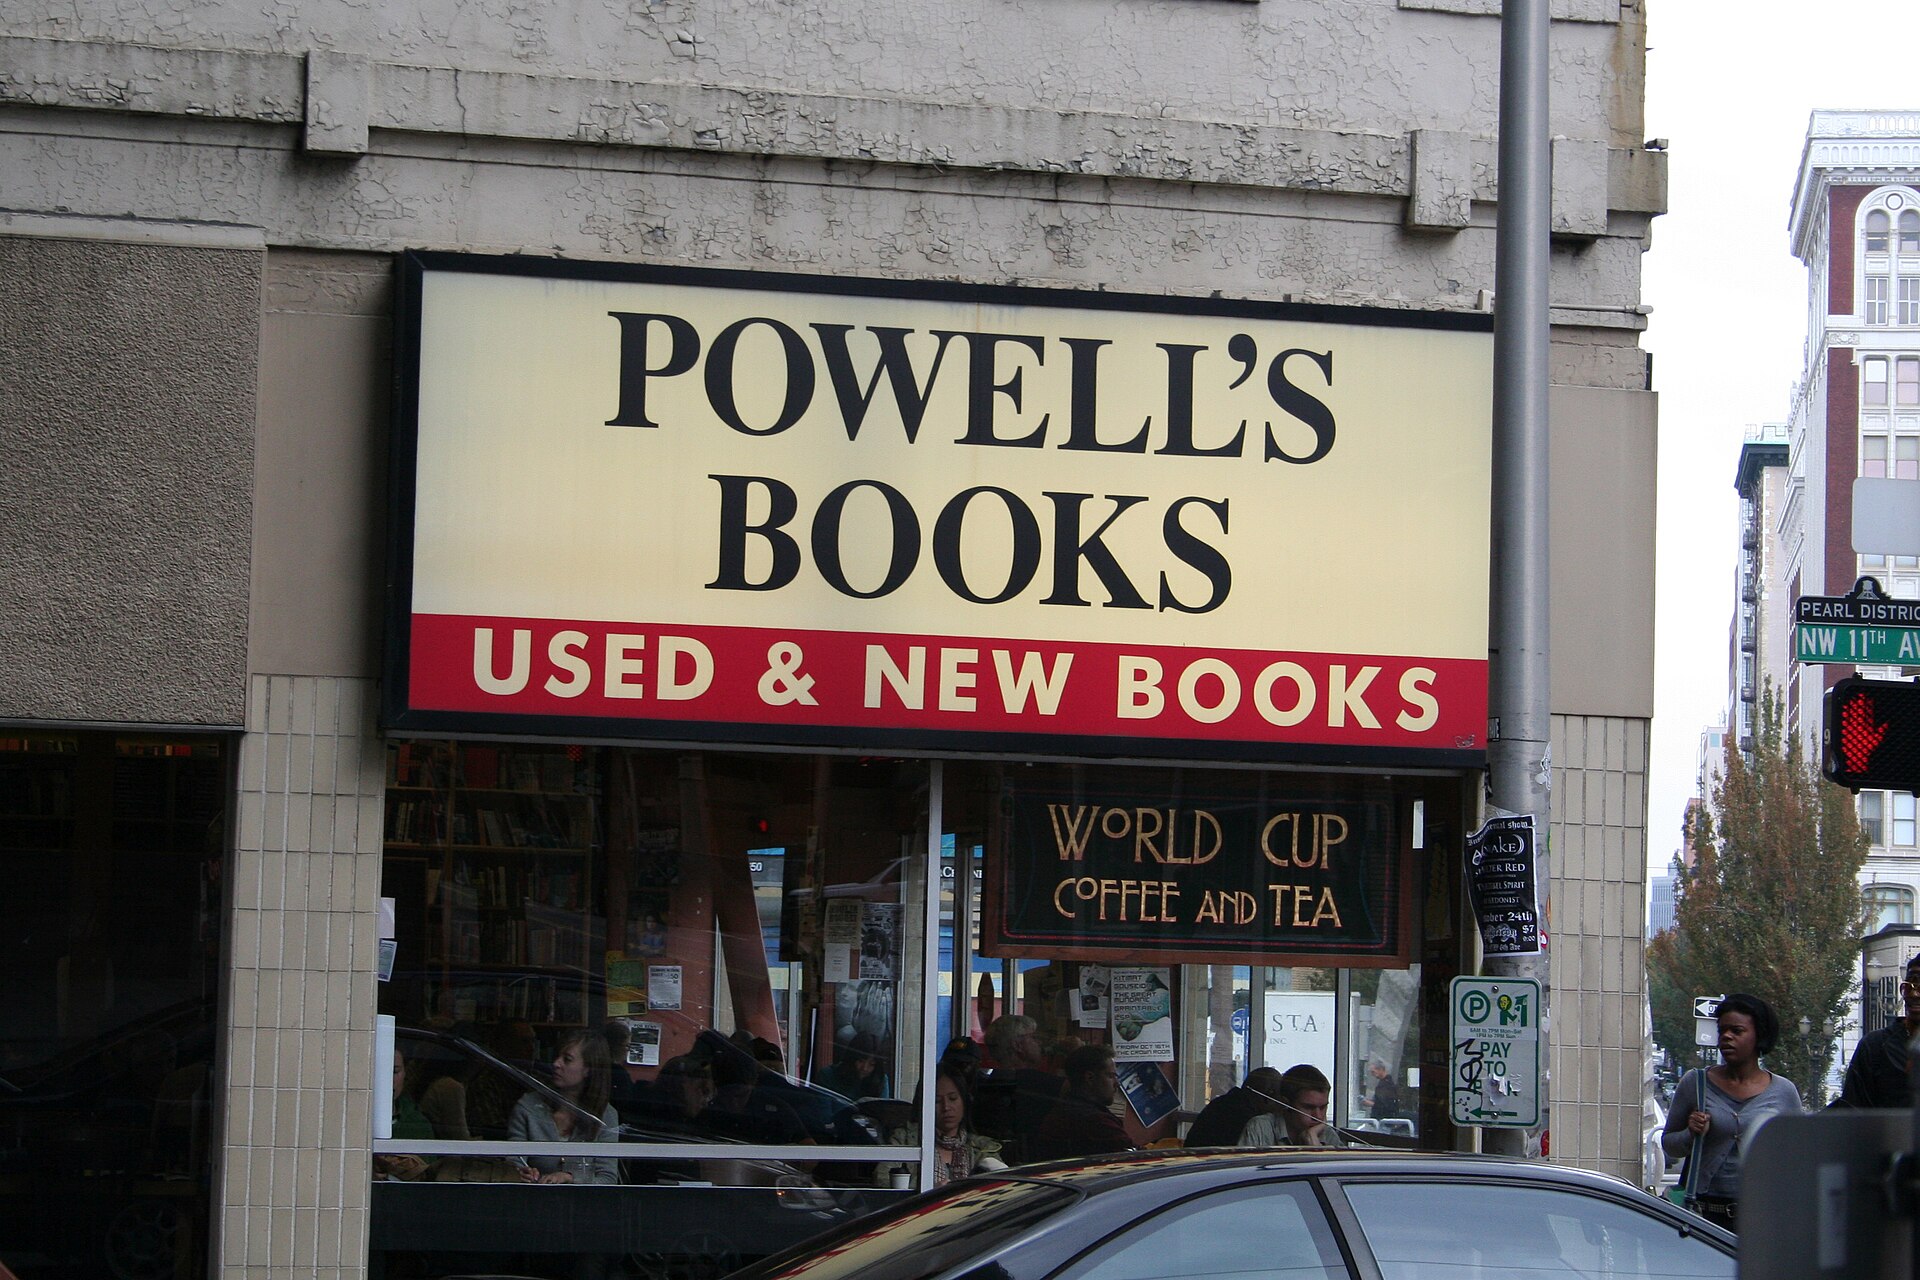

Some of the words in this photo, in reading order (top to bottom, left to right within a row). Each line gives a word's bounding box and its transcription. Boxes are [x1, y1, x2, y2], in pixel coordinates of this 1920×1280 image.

[604, 310, 1337, 465] POWELL'S
[704, 473, 1232, 614] BOOKS
[1801, 601, 1854, 618] PEARL
[1802, 627, 1837, 656] NW
[1849, 629, 1886, 657] 11TH
[473, 626, 714, 701] USED
[758, 640, 819, 708] &
[864, 644, 1075, 716] NEW
[1117, 655, 1439, 732] BOOKS
[1047, 804, 1222, 865] WORLD
[1261, 813, 1348, 869] CUP
[1505, 862, 1526, 872] RED
[1053, 877, 1181, 923] COFFEE
[1195, 890, 1257, 925] AND
[1267, 884, 1342, 928] TEA
[1507, 910, 1533, 923] 24th
[1521, 924, 1535, 934] $7
[1480, 1041, 1512, 1059] PAY
[1483, 1060, 1507, 1077] TO
